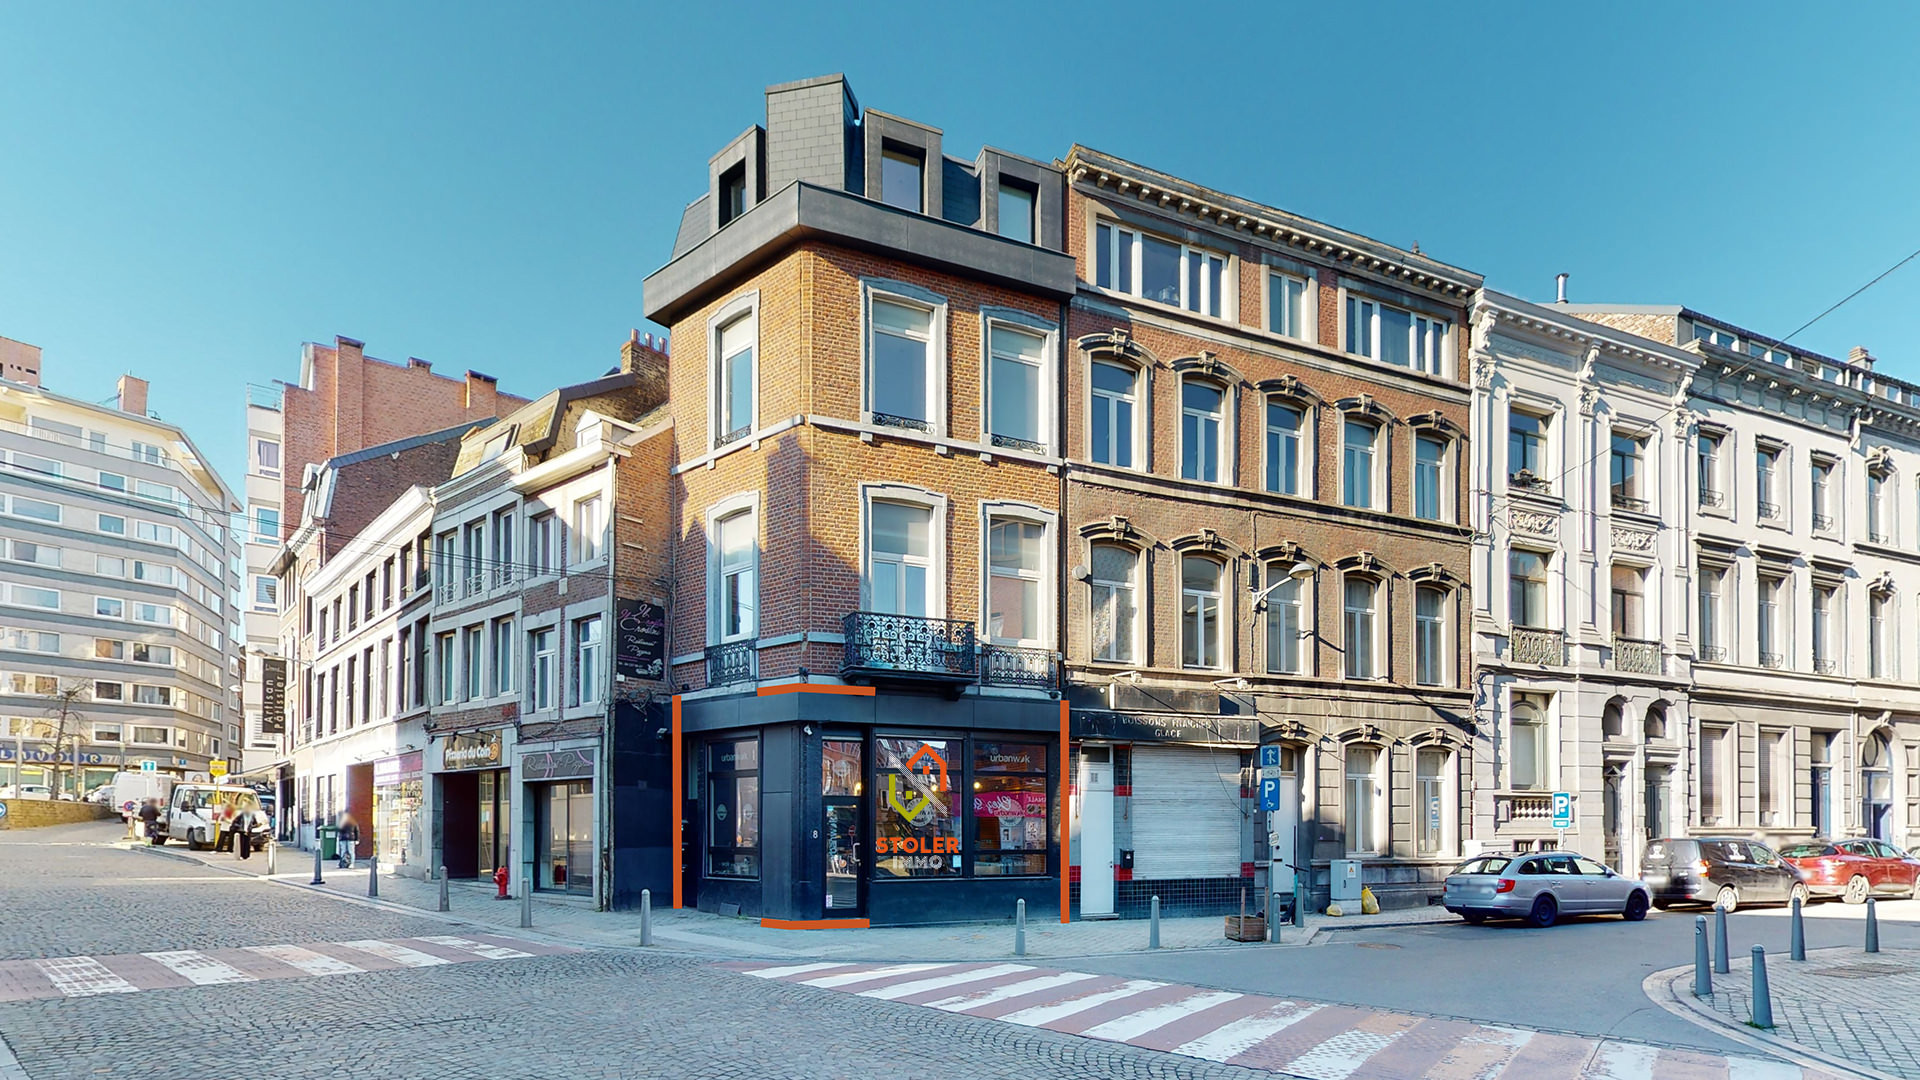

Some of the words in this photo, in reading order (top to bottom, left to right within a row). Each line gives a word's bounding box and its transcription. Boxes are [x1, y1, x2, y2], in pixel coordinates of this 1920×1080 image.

[264, 679, 274, 724] Artisan
[1154, 728, 1182, 739] GLACE
[467, 745, 476, 760] du
[476, 743, 491, 759] Coin
[1264, 780, 1276, 798] P
[1554, 796, 1569, 816] P
[812, 830, 819, 839] 8
